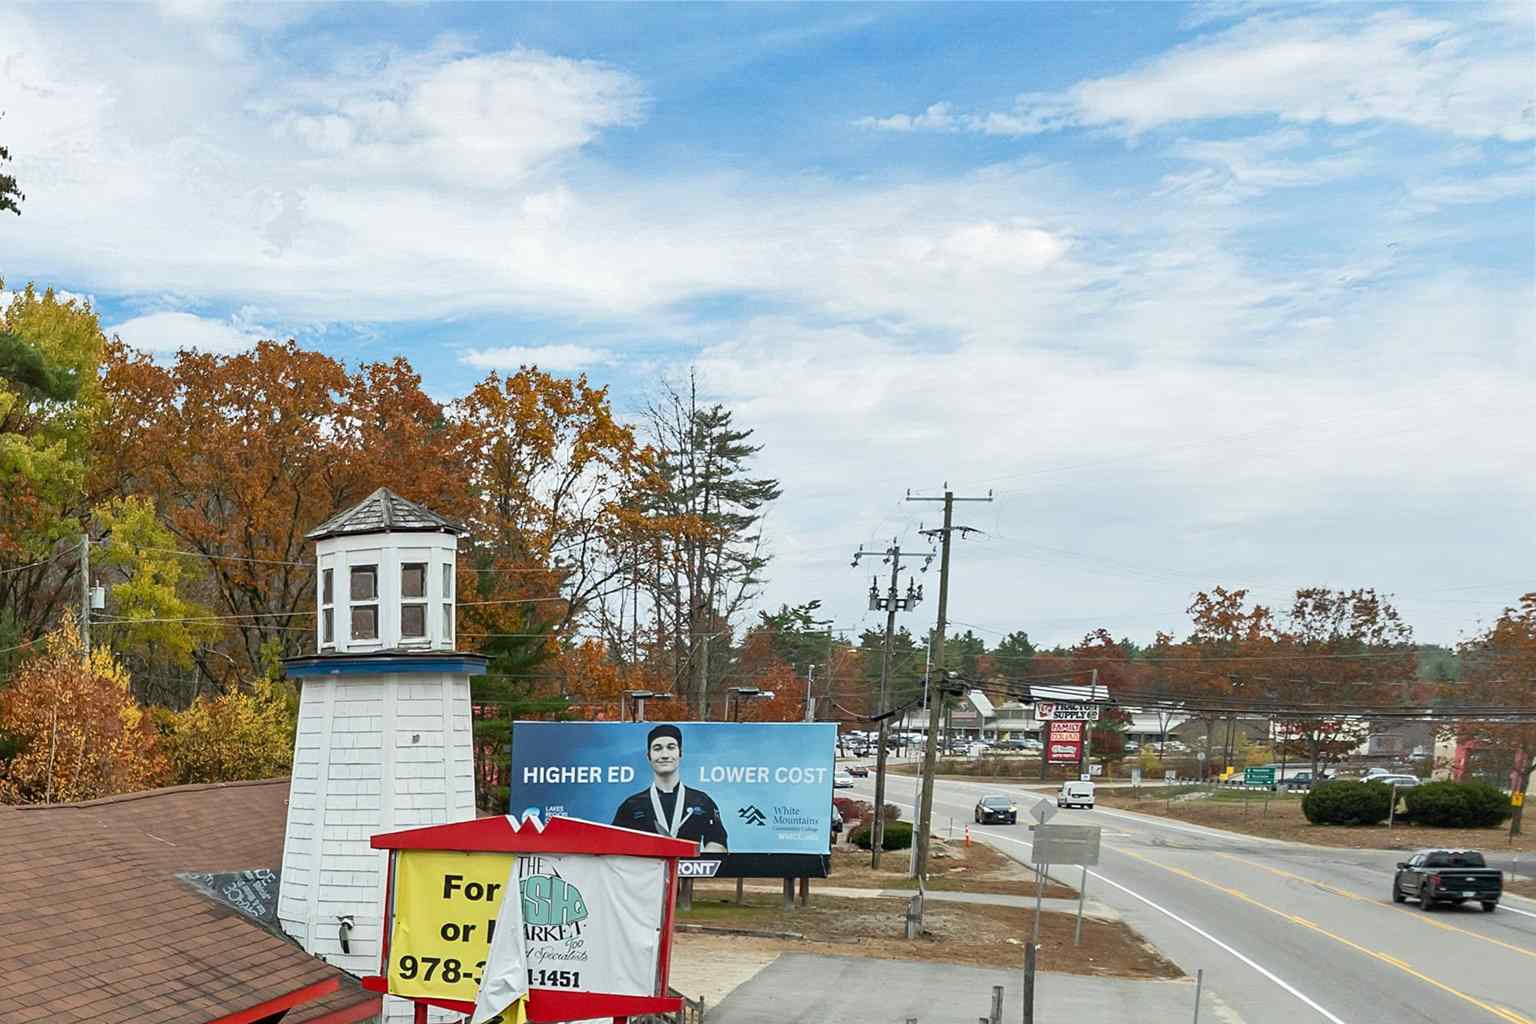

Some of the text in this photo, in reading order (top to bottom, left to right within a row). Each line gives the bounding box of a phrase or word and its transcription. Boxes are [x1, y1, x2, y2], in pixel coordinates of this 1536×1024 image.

[523, 766, 635, 784] HIGHER ED
[699, 766, 827, 784] LOWER COST
[774, 806, 800, 815] White
[773, 816, 819, 825] Mountains
[443, 874, 501, 902] For
[440, 922, 477, 942] or
